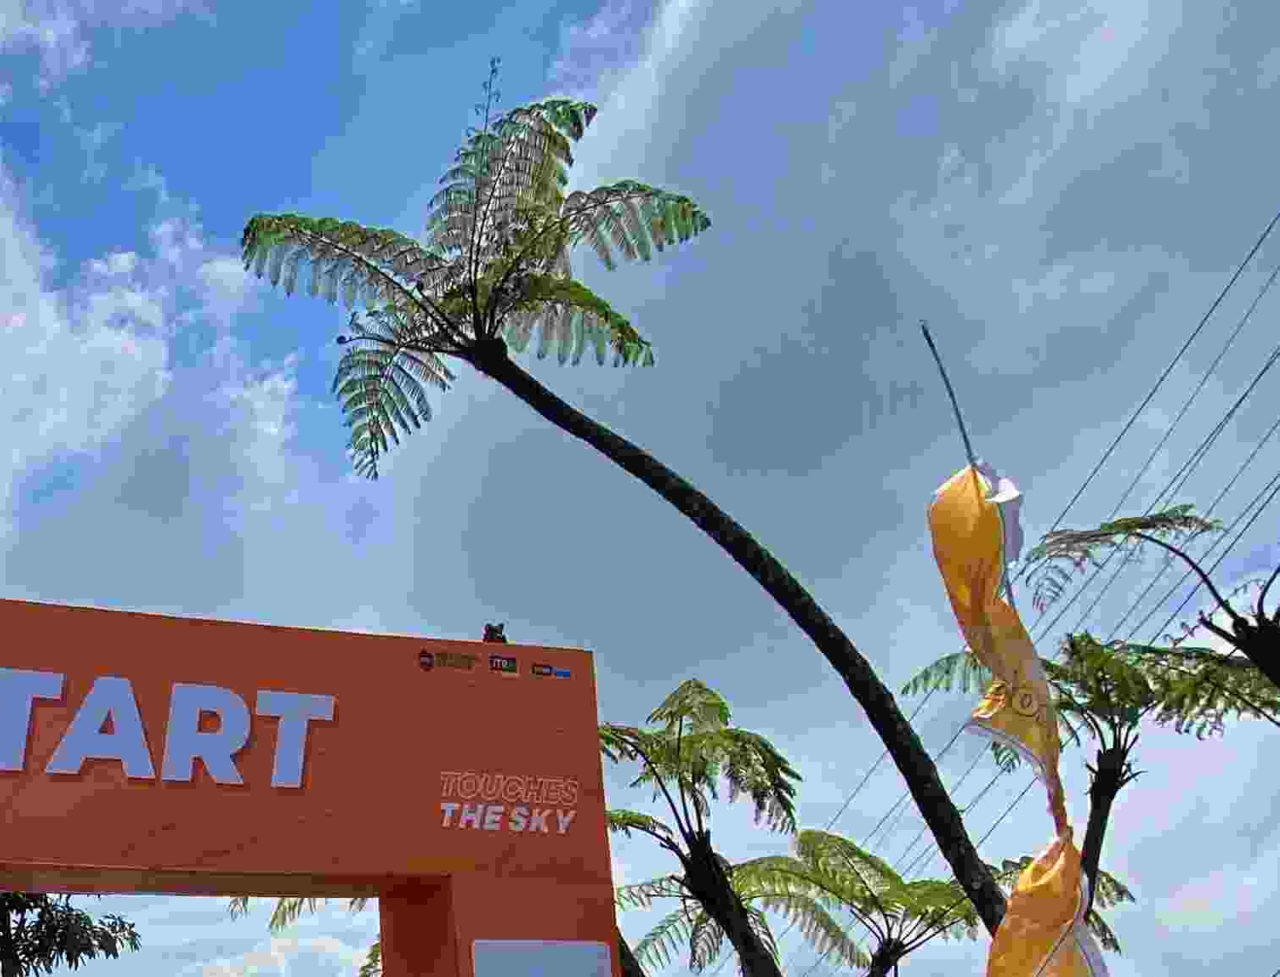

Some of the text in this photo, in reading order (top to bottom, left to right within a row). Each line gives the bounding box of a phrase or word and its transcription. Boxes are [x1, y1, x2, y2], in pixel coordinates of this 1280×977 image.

[440, 771, 578, 806] TOUCHES
[439, 802, 577, 834] THE SKY
